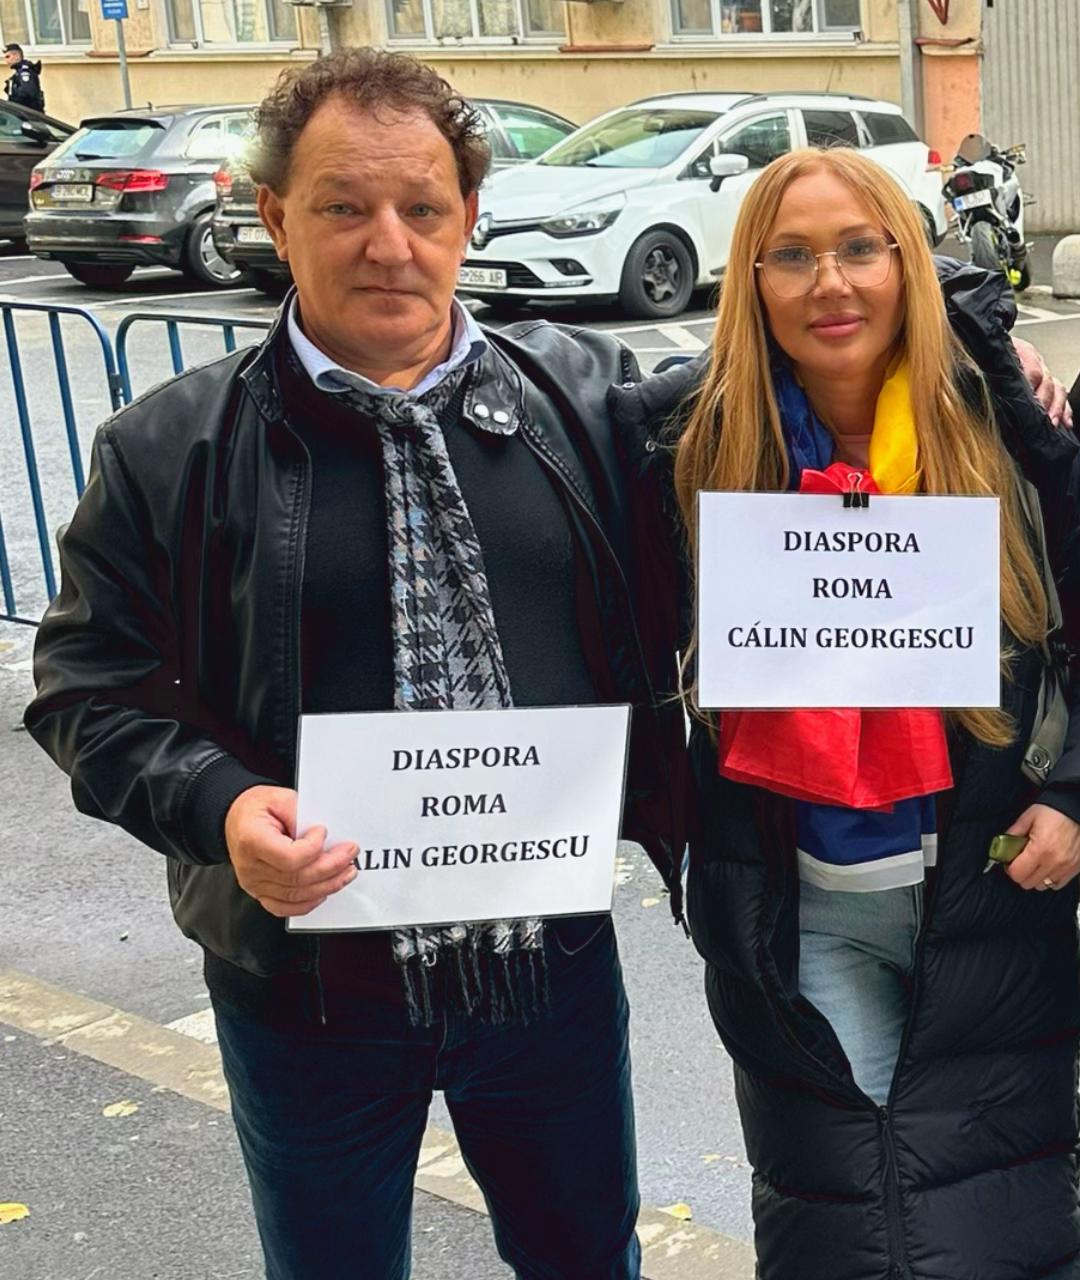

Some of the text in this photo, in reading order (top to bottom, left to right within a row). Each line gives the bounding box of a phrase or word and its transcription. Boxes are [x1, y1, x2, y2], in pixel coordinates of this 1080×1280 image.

[784, 531, 920, 553] DIASPORA
[812, 578, 893, 599] ROMA
[728, 620, 974, 649] CÁLIN GEORGESCU
[392, 745, 540, 771] DIASPORA
[421, 793, 507, 817] ROMA
[421, 835, 590, 868] GEORGESCU
